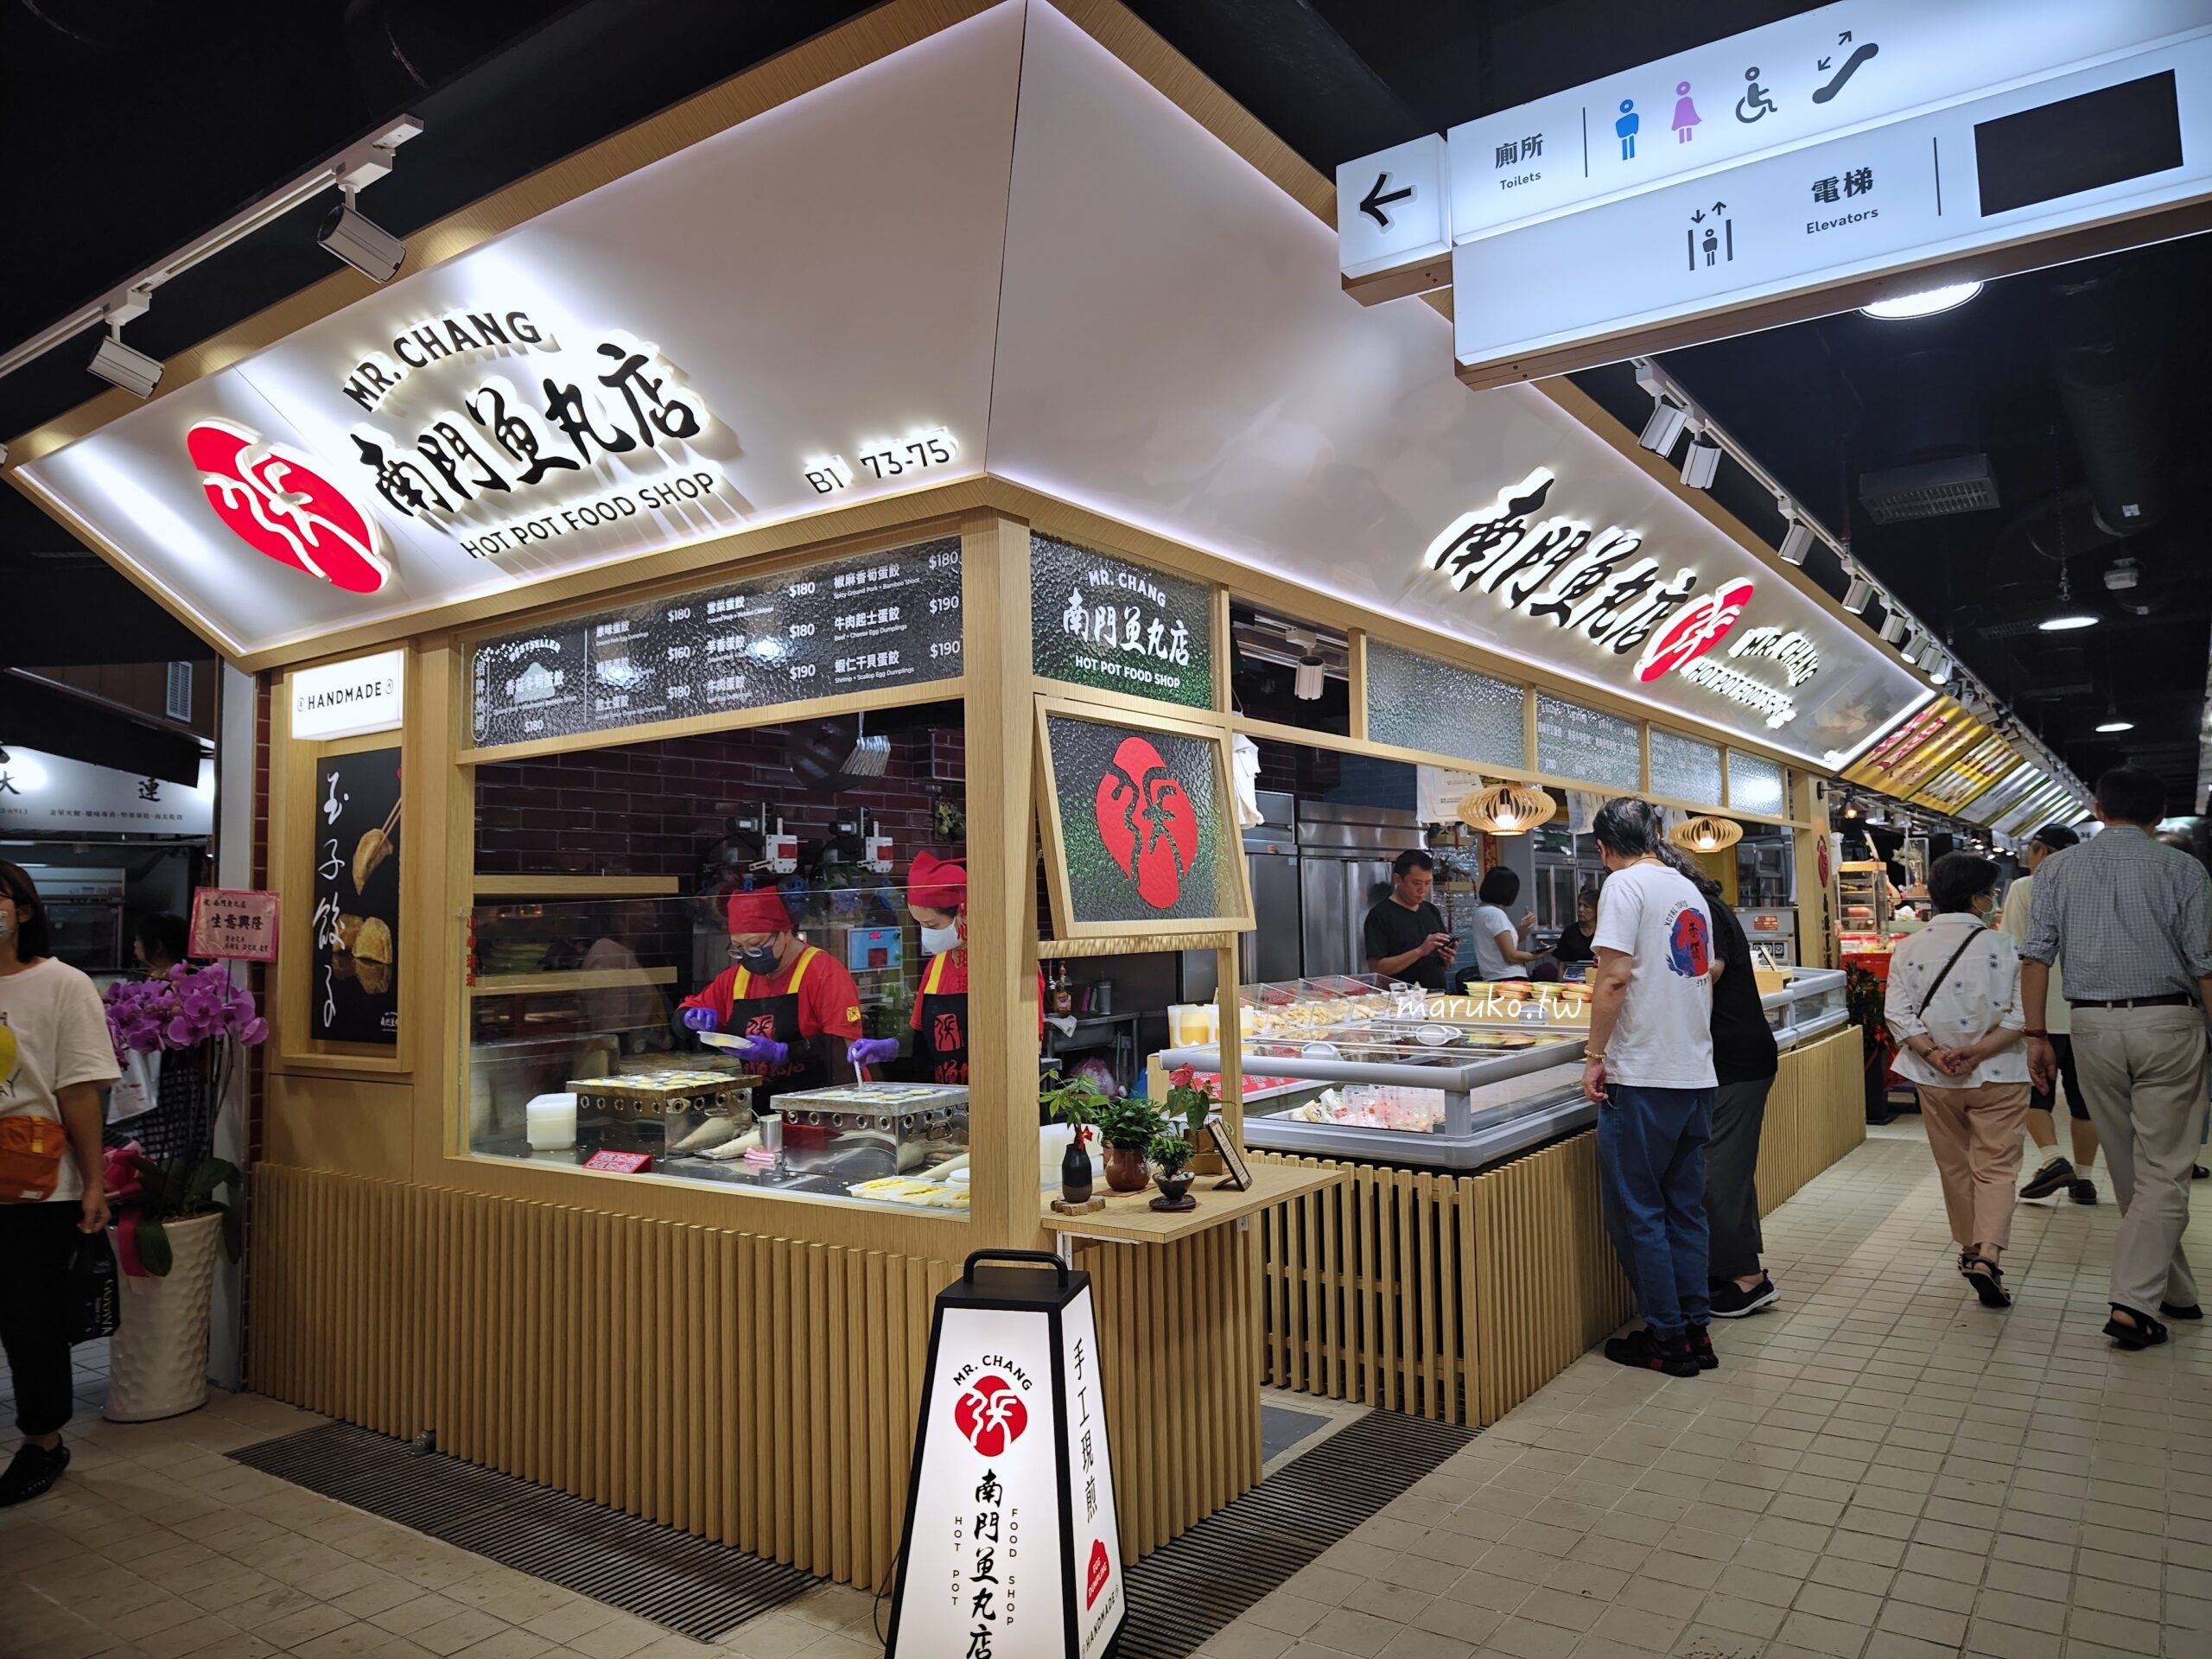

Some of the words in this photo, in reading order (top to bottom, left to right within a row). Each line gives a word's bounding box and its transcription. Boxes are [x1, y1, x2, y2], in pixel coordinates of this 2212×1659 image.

[1495, 133, 1544, 168] 廁所
[1500, 172, 1541, 190] Toilets
[1811, 167, 1873, 203] 電梯
[1806, 208, 1879, 235] Elevators
[343, 361, 403, 412] MR.
[393, 311, 543, 368] CHANG
[804, 467, 845, 494] B1
[860, 438, 950, 480] 73-75
[461, 531, 513, 559] HOT
[510, 516, 563, 546] POT
[560, 495, 637, 531] FOOD
[639, 471, 715, 510] SHOP
[928, 550, 959, 570] $180
[788, 582, 817, 599] $180
[1088, 569, 1115, 588] MR.
[1118, 572, 1166, 607] CHANG
[667, 607, 691, 624] $180
[834, 606, 900, 632] 牛肉起士蛋餃
[929, 595, 960, 615] $190
[788, 623, 816, 640] $180
[667, 645, 691, 663] $160
[834, 649, 900, 674] 蝦仁干貝蛋餃
[930, 640, 961, 659] $190
[1777, 639, 1819, 688] CHANG
[788, 664, 817, 681] $190
[1075, 655, 1098, 671] HOT
[1100, 660, 1122, 677] POT
[1123, 666, 1153, 683] FOOD
[1154, 673, 1181, 689] SHOP
[1686, 661, 1723, 687] HOT
[308, 681, 383, 710] HANDMADE
[666, 684, 691, 701] $180
[524, 719, 544, 734] $180
[211, 912, 264, 931] 生意興隆
[953, 1363, 979, 1387] MR.
[982, 1354, 1033, 1392] CHANG
[1073, 1337, 1098, 1524] 手工現煎
[953, 1516, 963, 1553] HOT
[1008, 1508, 1019, 1558] FOOD
[950, 1569, 961, 1606] POT
[1006, 1575, 1016, 1625] SHOP
[1085, 1591, 1116, 1653] HANDMADE
